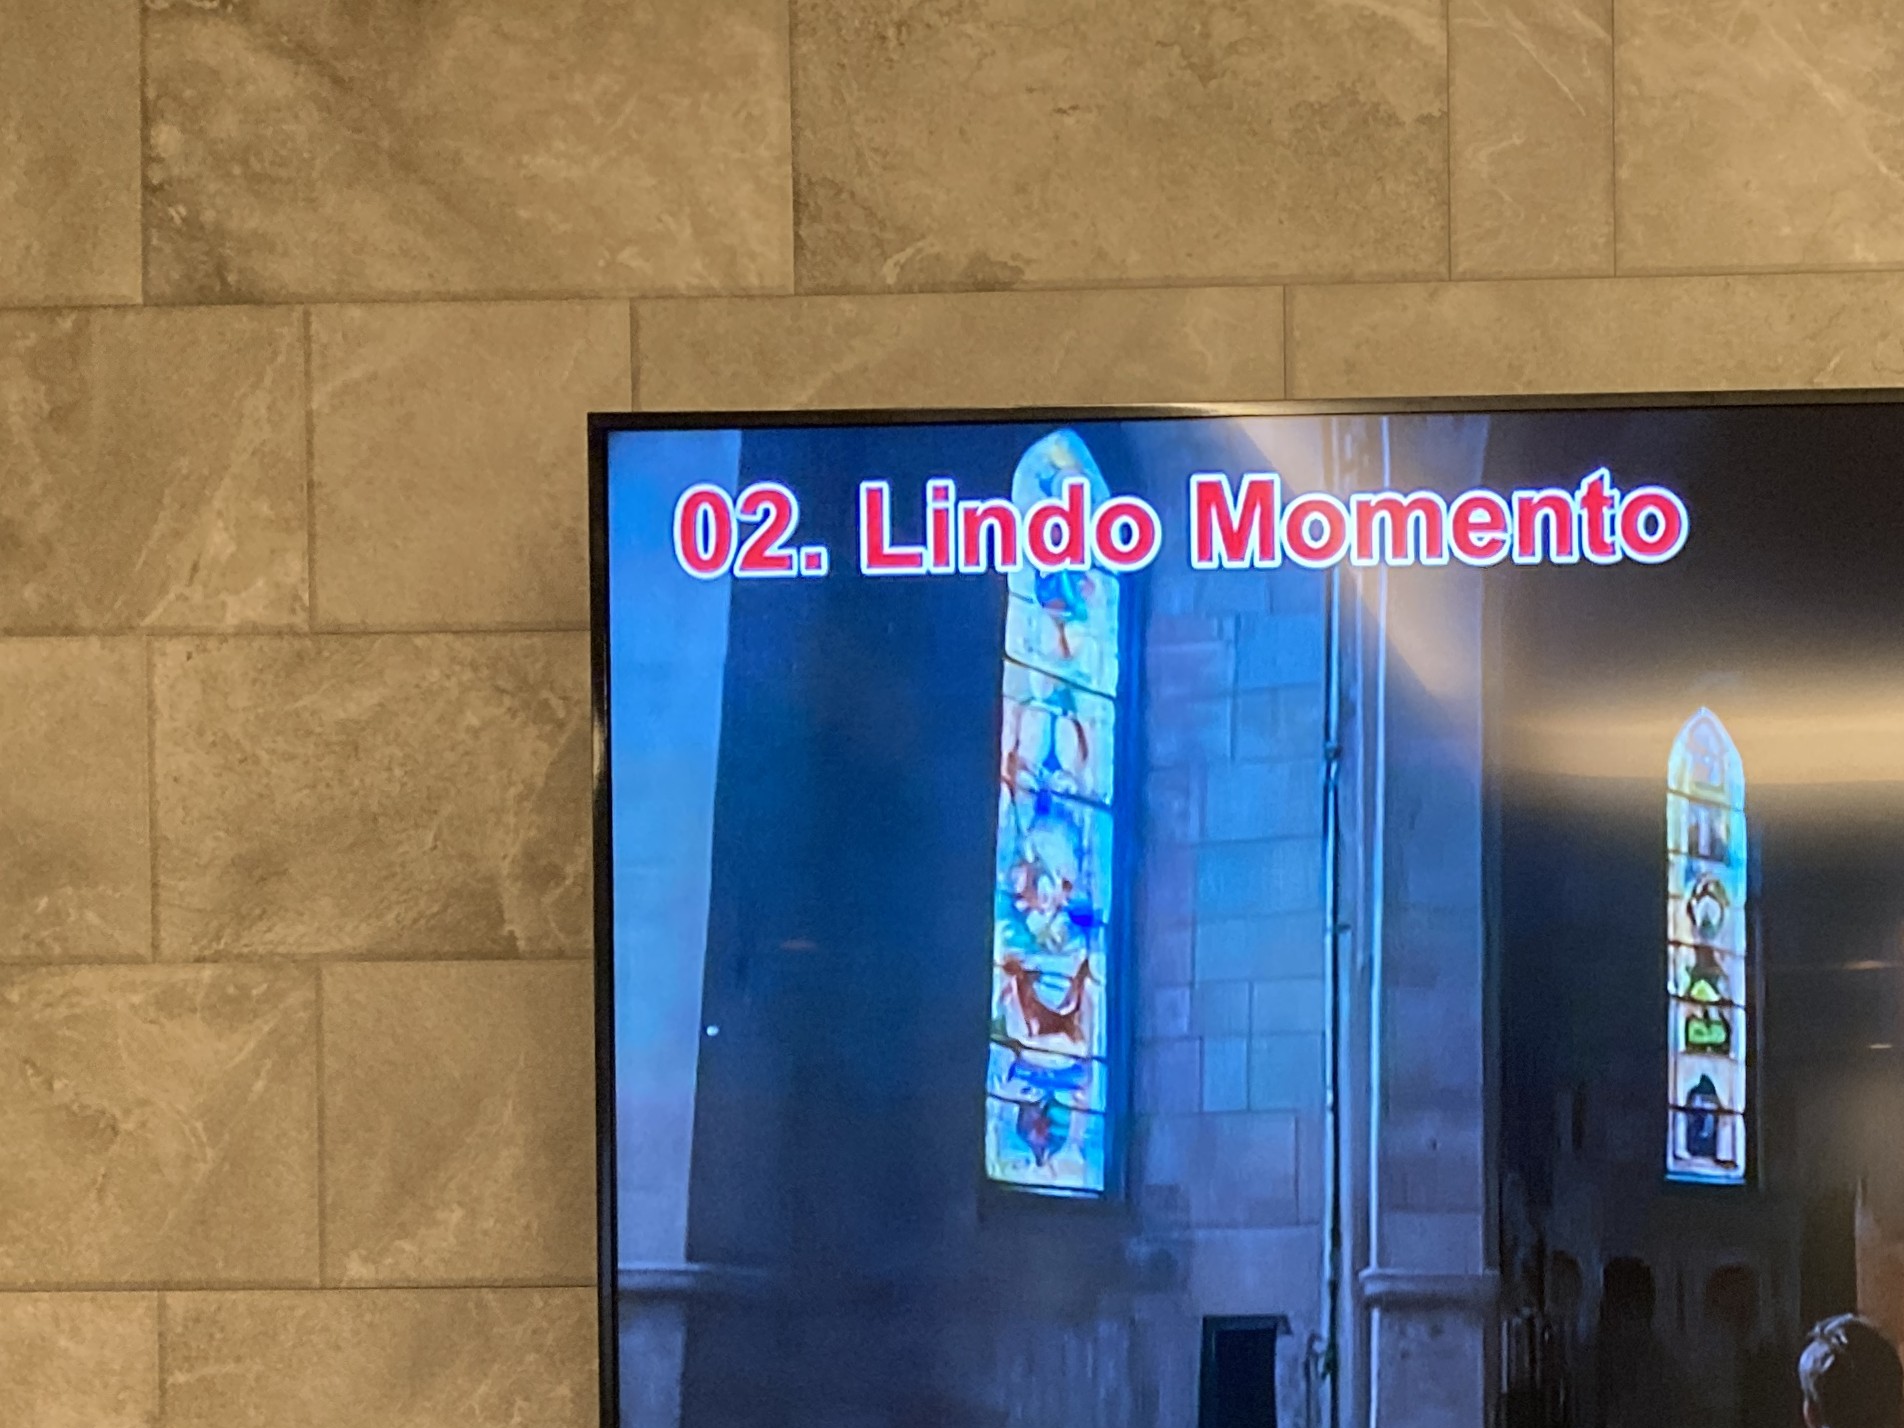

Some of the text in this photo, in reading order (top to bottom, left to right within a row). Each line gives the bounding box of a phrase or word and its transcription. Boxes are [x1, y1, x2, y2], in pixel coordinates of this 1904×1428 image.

[672, 467, 1690, 580] 02. Lindo Momento
